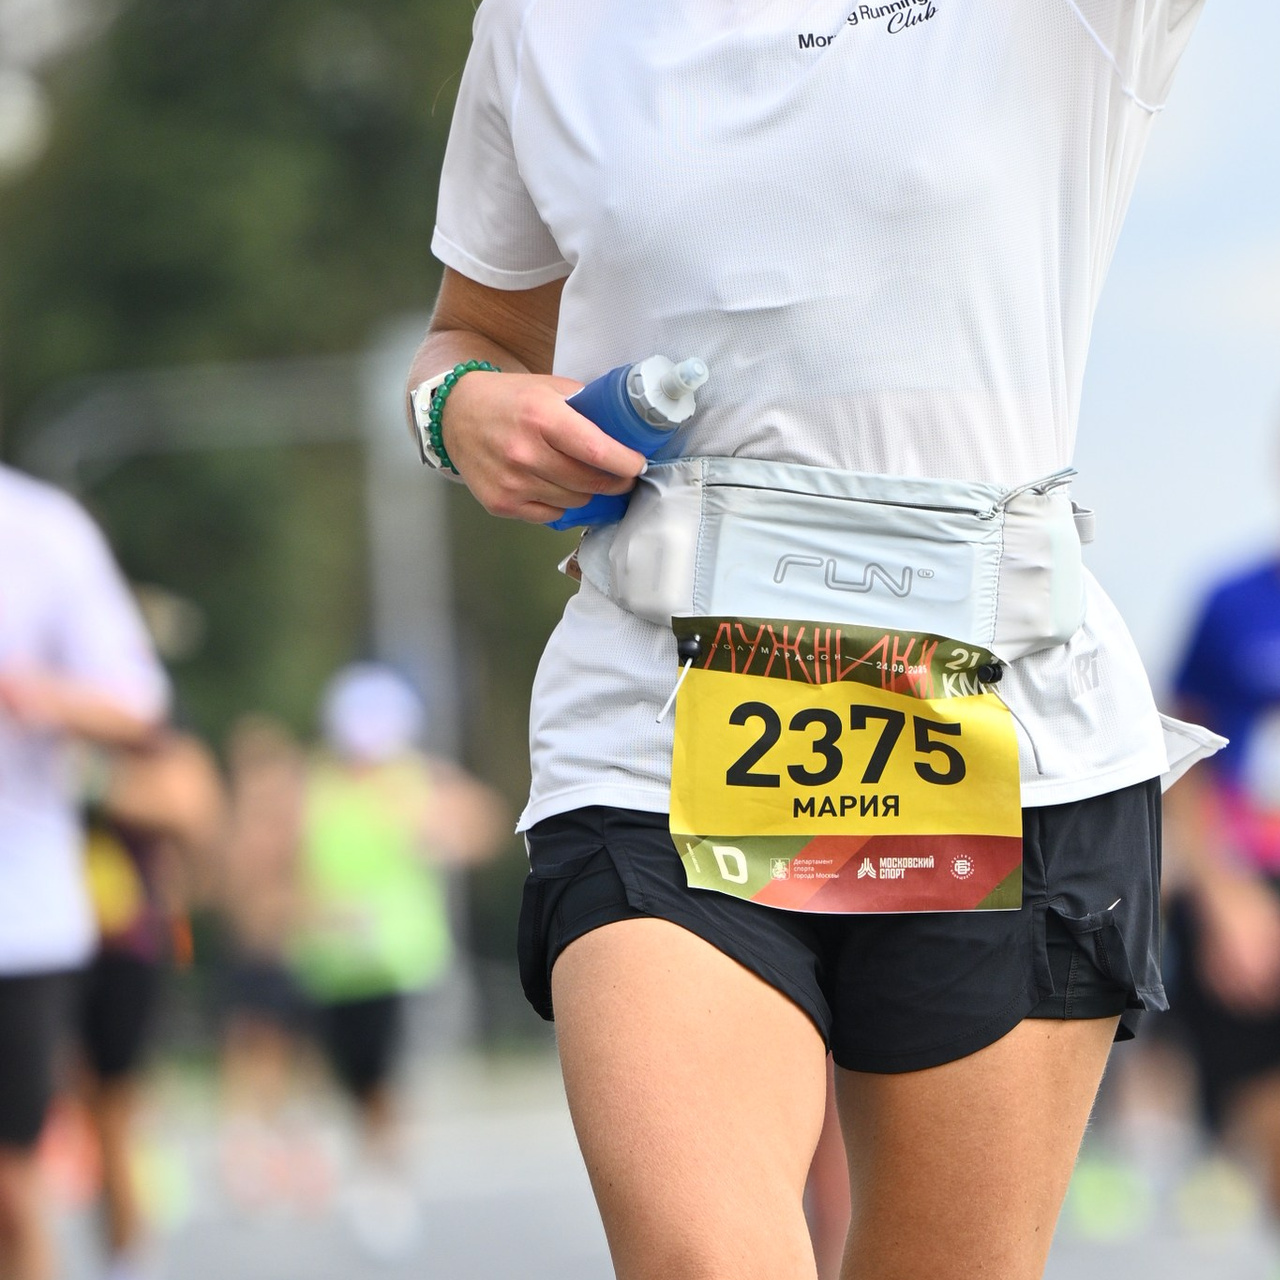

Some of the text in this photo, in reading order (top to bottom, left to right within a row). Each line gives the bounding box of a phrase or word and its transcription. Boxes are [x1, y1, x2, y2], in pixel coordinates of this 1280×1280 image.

[798, 10, 858, 49] Morg
[887, 1, 938, 34] Club
[711, 642, 842, 661] ПОЛУМАРАФОН
[726, 701, 966, 788] 2375
[793, 795, 900, 817] МАРИЯ
[712, 846, 748, 884] D
[880, 855, 934, 868] МОСКОВСКИЙ
[880, 869, 906, 879] СПОРТ
